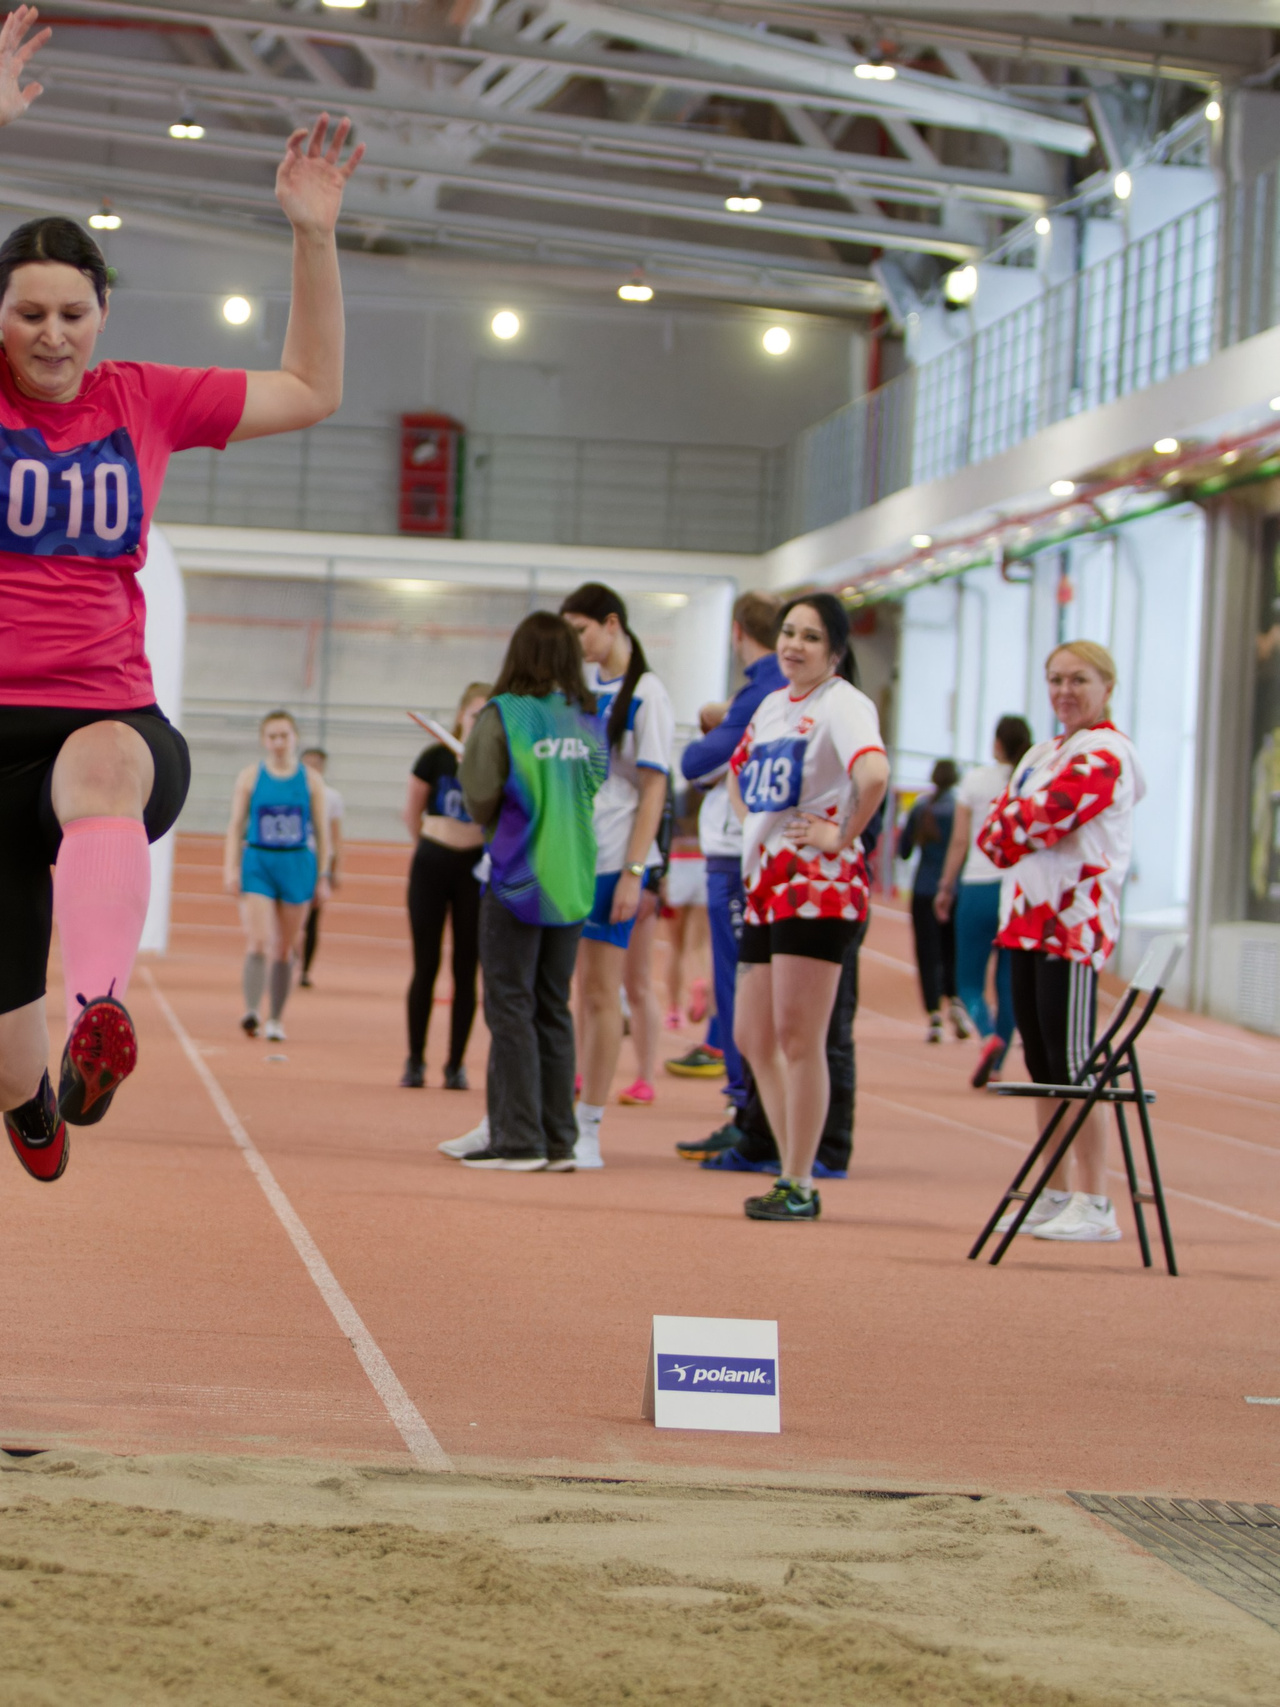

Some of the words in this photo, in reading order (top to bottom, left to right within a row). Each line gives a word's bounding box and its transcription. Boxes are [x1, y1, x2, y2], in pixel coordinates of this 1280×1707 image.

[6, 458, 130, 542] 010
[743, 756, 792, 805] 243
[692, 1366, 768, 1385] polanik
